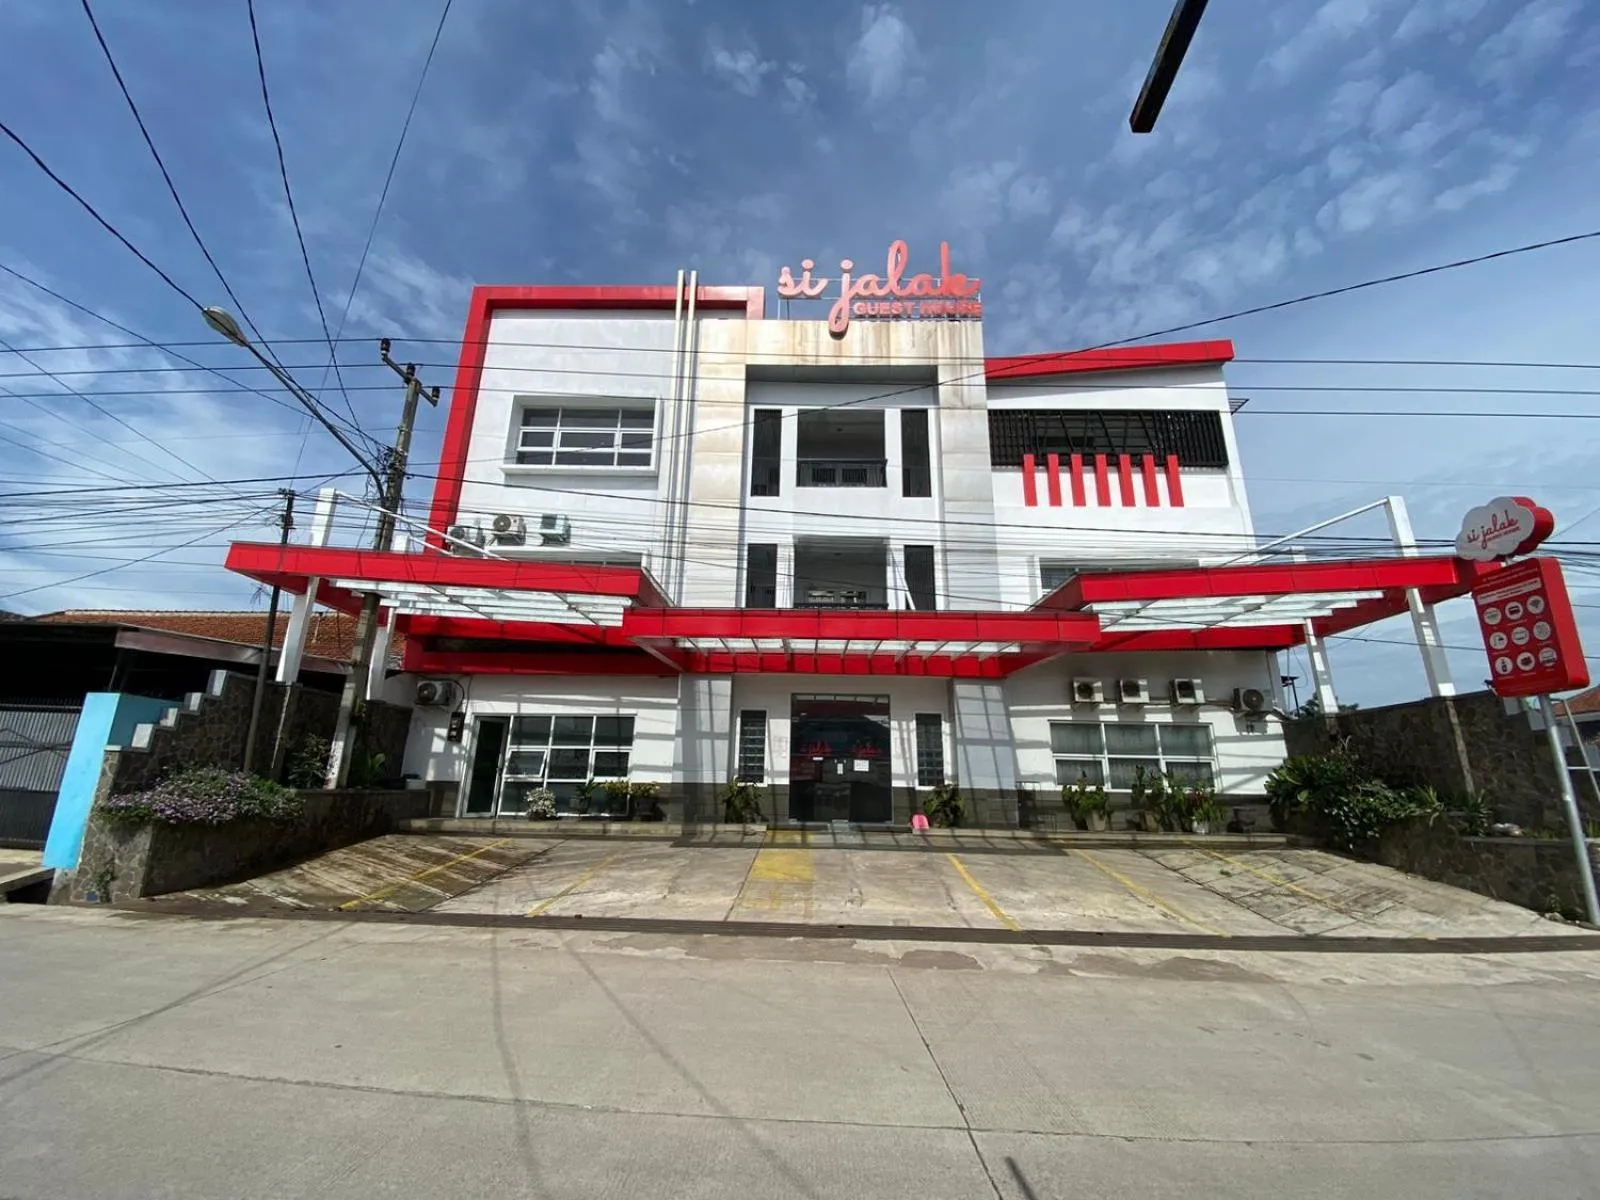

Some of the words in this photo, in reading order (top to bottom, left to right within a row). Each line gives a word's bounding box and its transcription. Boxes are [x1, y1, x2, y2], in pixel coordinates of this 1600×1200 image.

[777, 258, 828, 297] si
[828, 239, 982, 339] jalak
[853, 301, 915, 316] GUEST
[1466, 528, 1480, 544] si
[1480, 509, 1519, 550] jalak
